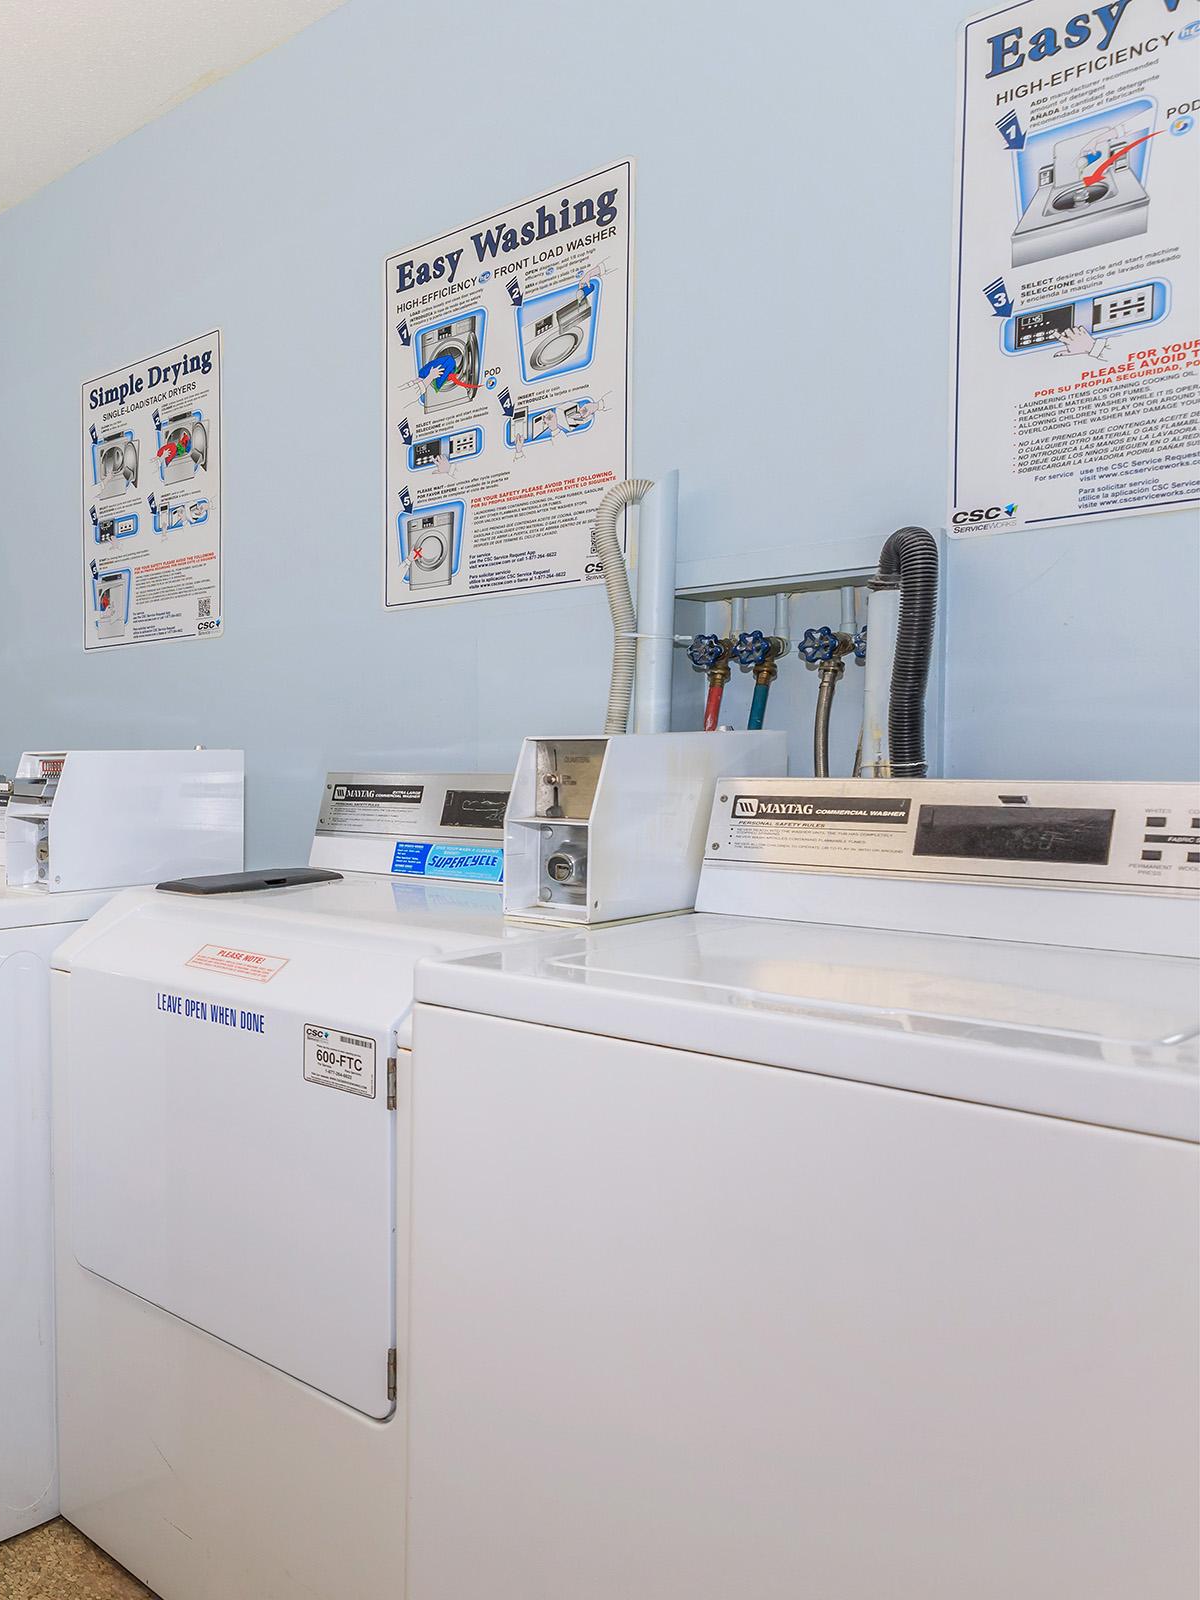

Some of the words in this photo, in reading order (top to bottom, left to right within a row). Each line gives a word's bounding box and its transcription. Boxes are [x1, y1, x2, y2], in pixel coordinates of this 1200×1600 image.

[985, 0, 1133, 79] Easy
[996, 31, 1174, 105] HIGH-EFFICIENCY
[1031, 97, 1047, 107] ADD
[1049, 79, 1100, 100] manufacturer
[1102, 58, 1159, 82] recommended
[1069, 84, 1106, 102] detergent
[1006, 124, 1017, 140] 1
[396, 248, 464, 293] Easy
[470, 188, 618, 262] Washing
[396, 276, 477, 314] HIGH-EFFICIENCY
[493, 258, 530, 280] FRONT
[532, 246, 563, 266] LOAD
[566, 226, 617, 254] WASHER
[1021, 277, 1053, 291] SELECT
[1055, 270, 1084, 282] desired
[1086, 265, 1106, 276] cycle
[1108, 260, 1123, 269] and
[1124, 255, 1143, 264] start
[1144, 246, 1179, 259] machine
[512, 289, 521, 300] 2
[1020, 280, 1075, 298] SELECCIONE
[993, 293, 1007, 307] 3
[1128, 349, 1157, 361] FOR
[484, 366, 501, 378] POD
[1081, 362, 1135, 380] PLEASE
[1140, 352, 1186, 368] AVOID
[89, 373, 143, 410] Simple
[147, 350, 212, 388] Drying
[168, 381, 197, 399] DRYERS
[1034, 388, 1054, 398] POR
[1057, 385, 1071, 394] SU
[1074, 377, 1113, 390] PROPIA
[1019, 395, 1066, 409] LAUNDERING
[1068, 390, 1091, 401] ITEMS
[1092, 381, 1140, 395] CONTAINING
[1142, 373, 1179, 385] COOKING
[503, 400, 512, 410] 4
[1018, 402, 1063, 415] FLAMMABLE
[1065, 394, 1108, 407] MATERIALS
[1109, 391, 1121, 399] OR
[1018, 411, 1056, 422] REACHING
[1058, 407, 1075, 415] INTO
[1094, 397, 1128, 408] WASHER
[1130, 392, 1155, 402] WHILE
[1018, 417, 1056, 429] ALLOWING
[1058, 410, 1097, 422] CHILDREN
[1099, 407, 1109, 415] TO
[1111, 402, 1131, 412] PLAY
[1133, 400, 1145, 408] ON
[1160, 392, 1195, 404] AROUND
[1018, 421, 1071, 436] OVERLOADING
[1090, 412, 1123, 424] WASHER
[1125, 409, 1141, 417] MAY
[1142, 402, 1179, 414] DAMAGE
[1051, 430, 1087, 442] PRENDAS
[1107, 419, 1158, 433] CONTENGAN
[1159, 413, 1189, 424] ACEITE
[402, 427, 411, 439] 3
[1025, 441, 1068, 453] CUALQUIER
[1070, 437, 1091, 446] OTRO
[1092, 430, 1132, 442] MATERIAL
[1030, 446, 1078, 459] INTRODUZCA
[1096, 438, 1125, 448] MANOS
[1150, 425, 1197, 438] LAVADORA
[1017, 460, 1071, 474] SOBRECARGAR
[1083, 452, 1125, 464] LAVADORA
[1034, 474, 1047, 482] For
[1048, 471, 1074, 480] service
[1096, 465, 1109, 473] the
[1111, 461, 1129, 470] CSC
[1131, 458, 1162, 468] Service
[499, 489, 520, 498] SAFETY
[521, 485, 543, 494] PLEASE
[544, 481, 562, 489] AVOID
[576, 470, 613, 483] FOLLOWING
[1078, 487, 1095, 496] Para
[1097, 482, 1127, 493] solicitar
[1128, 478, 1159, 488] servicio
[402, 496, 410, 507] 5
[952, 507, 1002, 524] CSC
[585, 562, 604, 573] CS
[197, 620, 215, 631] CSC
[346, 790, 375, 798] MAYTAG
[758, 803, 814, 815] MAYTAG
[815, 808, 868, 816] COMMERCIAL
[428, 855, 499, 869] SUPERCYCLE
[217, 949, 244, 960] PLEASE
[157, 992, 182, 1015] LEAVE
[185, 998, 207, 1021] OPEN
[210, 1003, 237, 1028] WHEN
[240, 1010, 265, 1034] DONE
[306, 1028, 324, 1038] CSC
[316, 1049, 362, 1072] 600-FTC
